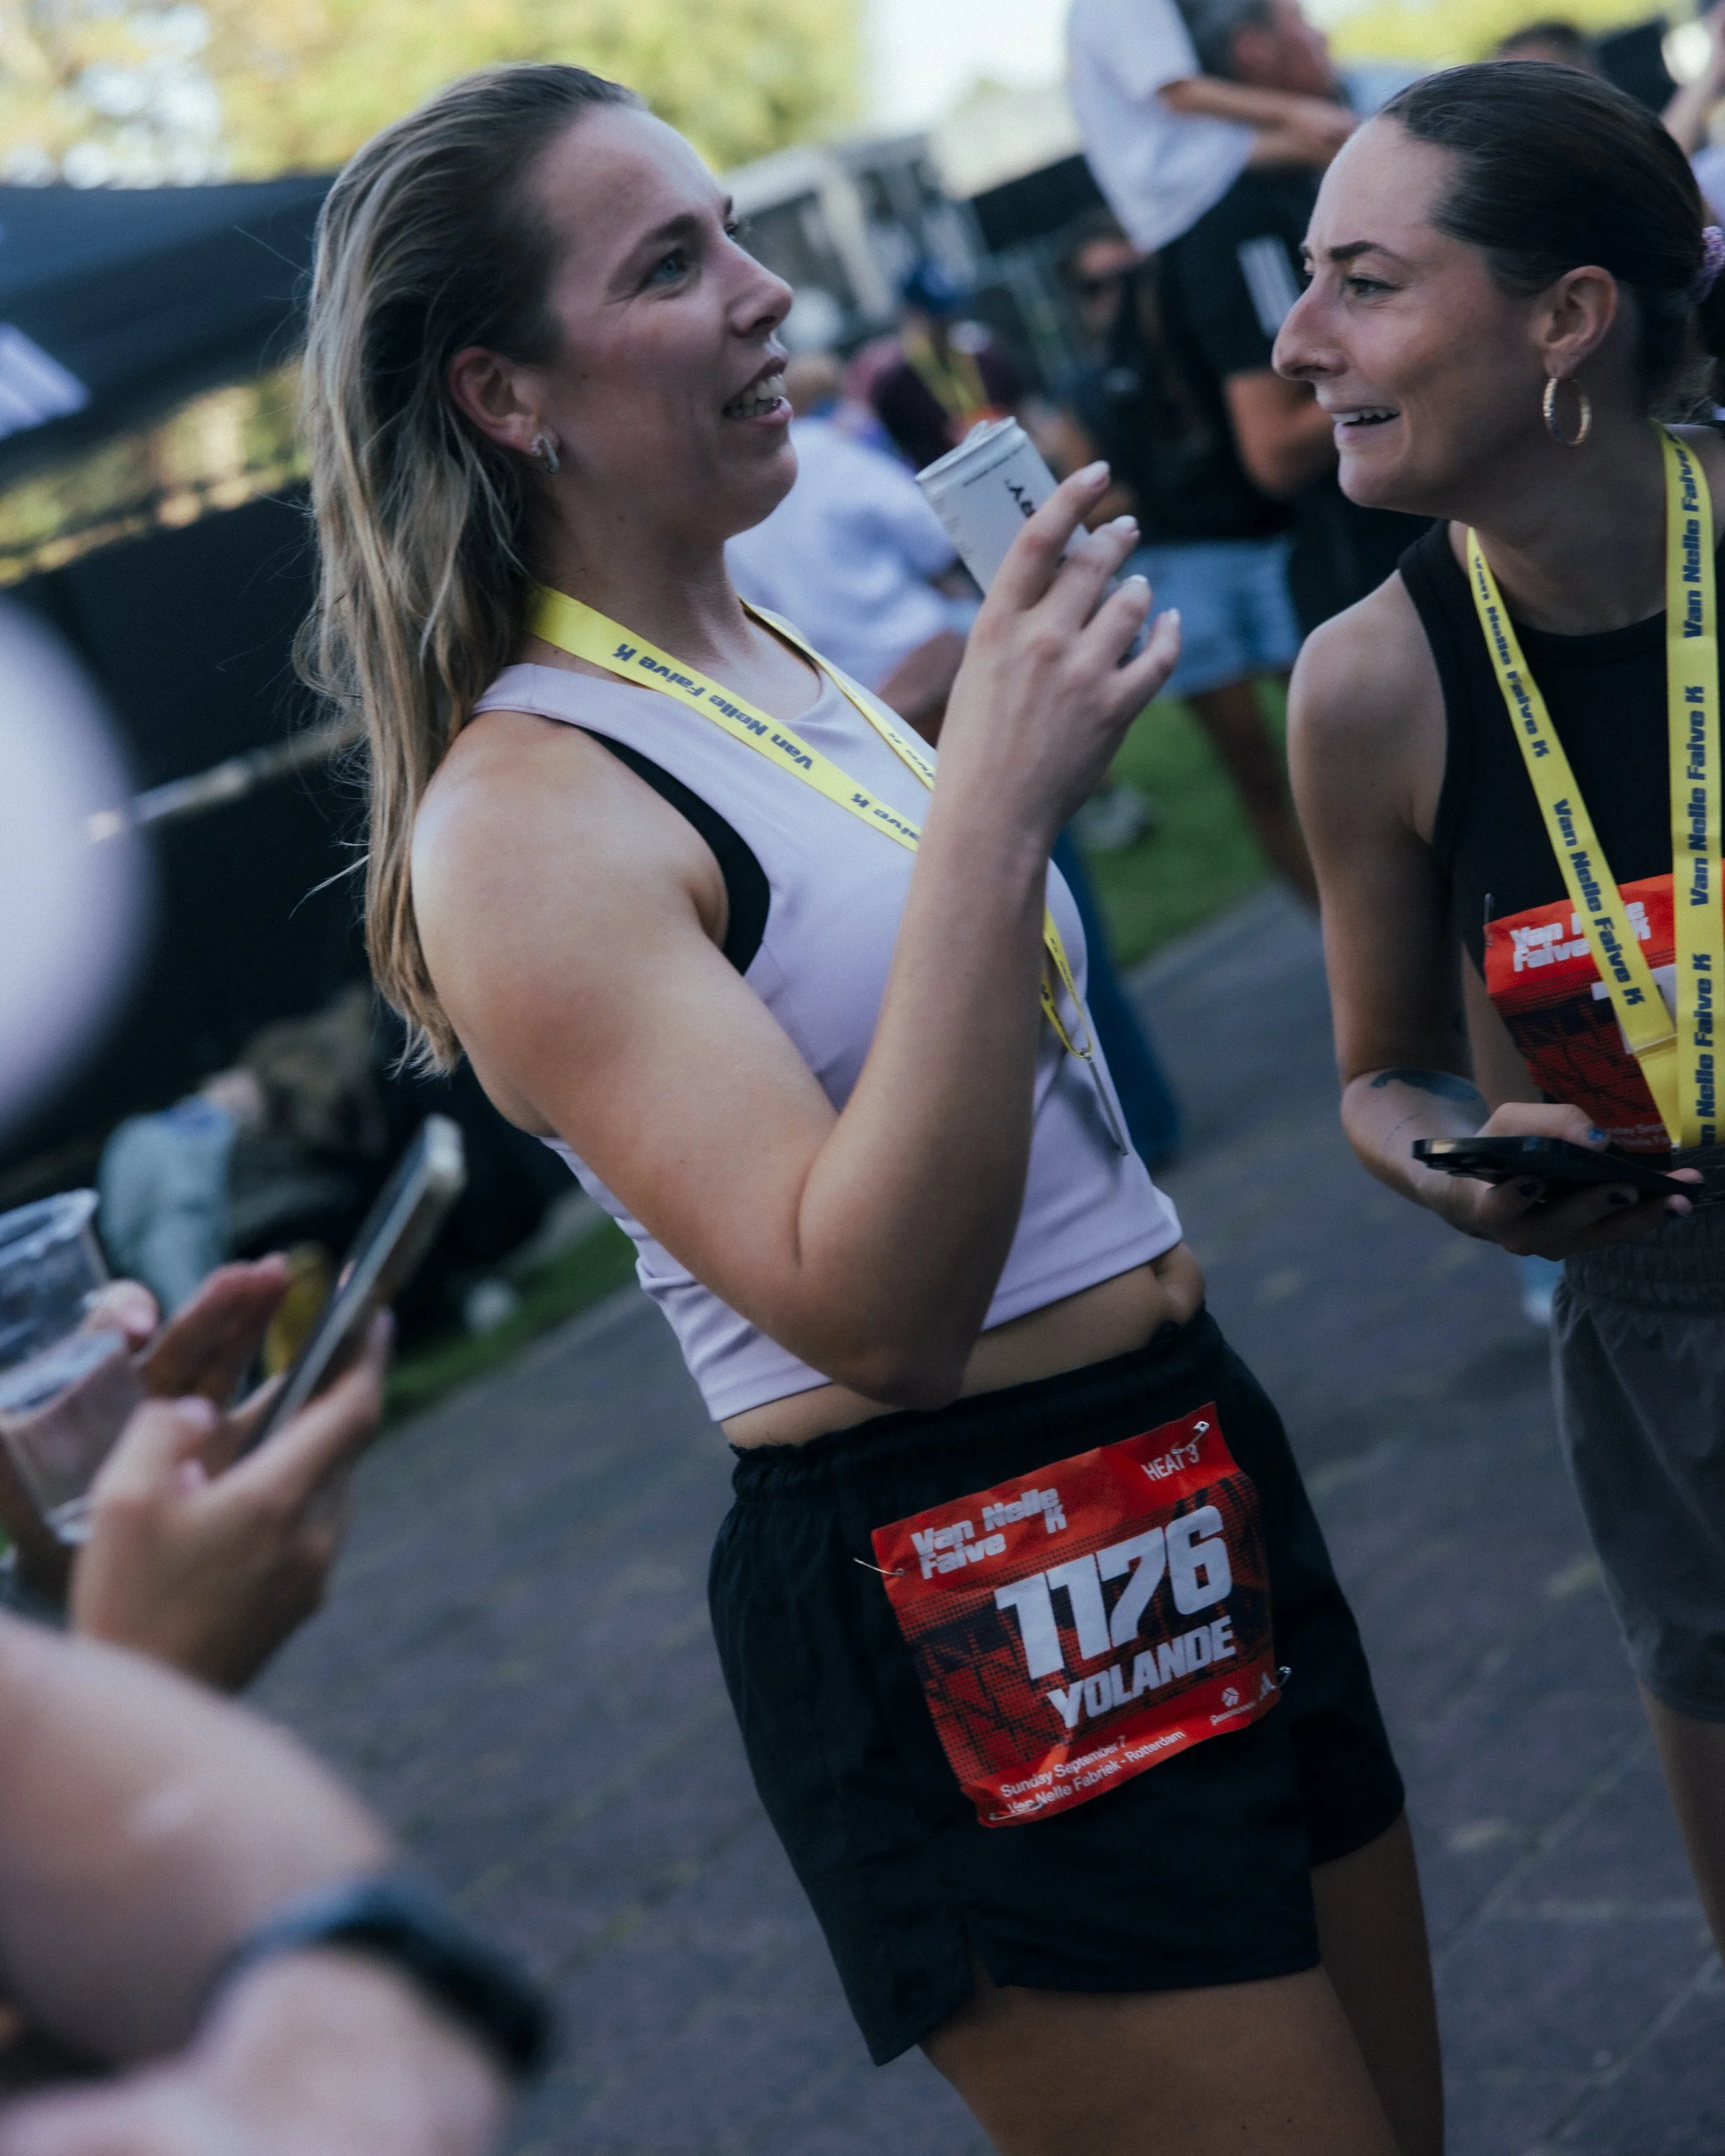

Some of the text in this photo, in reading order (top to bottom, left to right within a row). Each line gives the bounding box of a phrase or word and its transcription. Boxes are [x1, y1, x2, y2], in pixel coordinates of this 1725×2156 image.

[1682, 519, 1701, 583] Nelle
[1683, 590, 1703, 638] Van
[612, 643, 814, 770] Van Nelle Faive K
[1531, 740, 1550, 757] K
[850, 793, 921, 842] aive K
[1685, 685, 1709, 906] Van Nelle Faive K
[1552, 798, 1578, 847] Van
[1569, 851, 1603, 913] Nelle
[1593, 916, 1632, 983] Faive
[1622, 987, 1646, 1006] K
[1509, 922, 1564, 949] Van
[1512, 937, 1591, 973] Faive
[1692, 953, 1712, 972] K
[1693, 977, 1714, 1048] Faive
[1696, 1054, 1716, 1118] Nelle
[1140, 1443, 1200, 1481] HEAT 3
[911, 1487, 1060, 1557] Van Nelle
[919, 1504, 1067, 1580] Faive K
[994, 1505, 1233, 1680] 1176
[1046, 1615, 1237, 1729] YOLANDE
[1000, 1735, 1127, 1797] Sunday September 7
[1035, 1784, 1072, 1805] Nelle
[1072, 1759, 1122, 1791] Fabriek
[1124, 1731, 1186, 1762] Rotterdam
